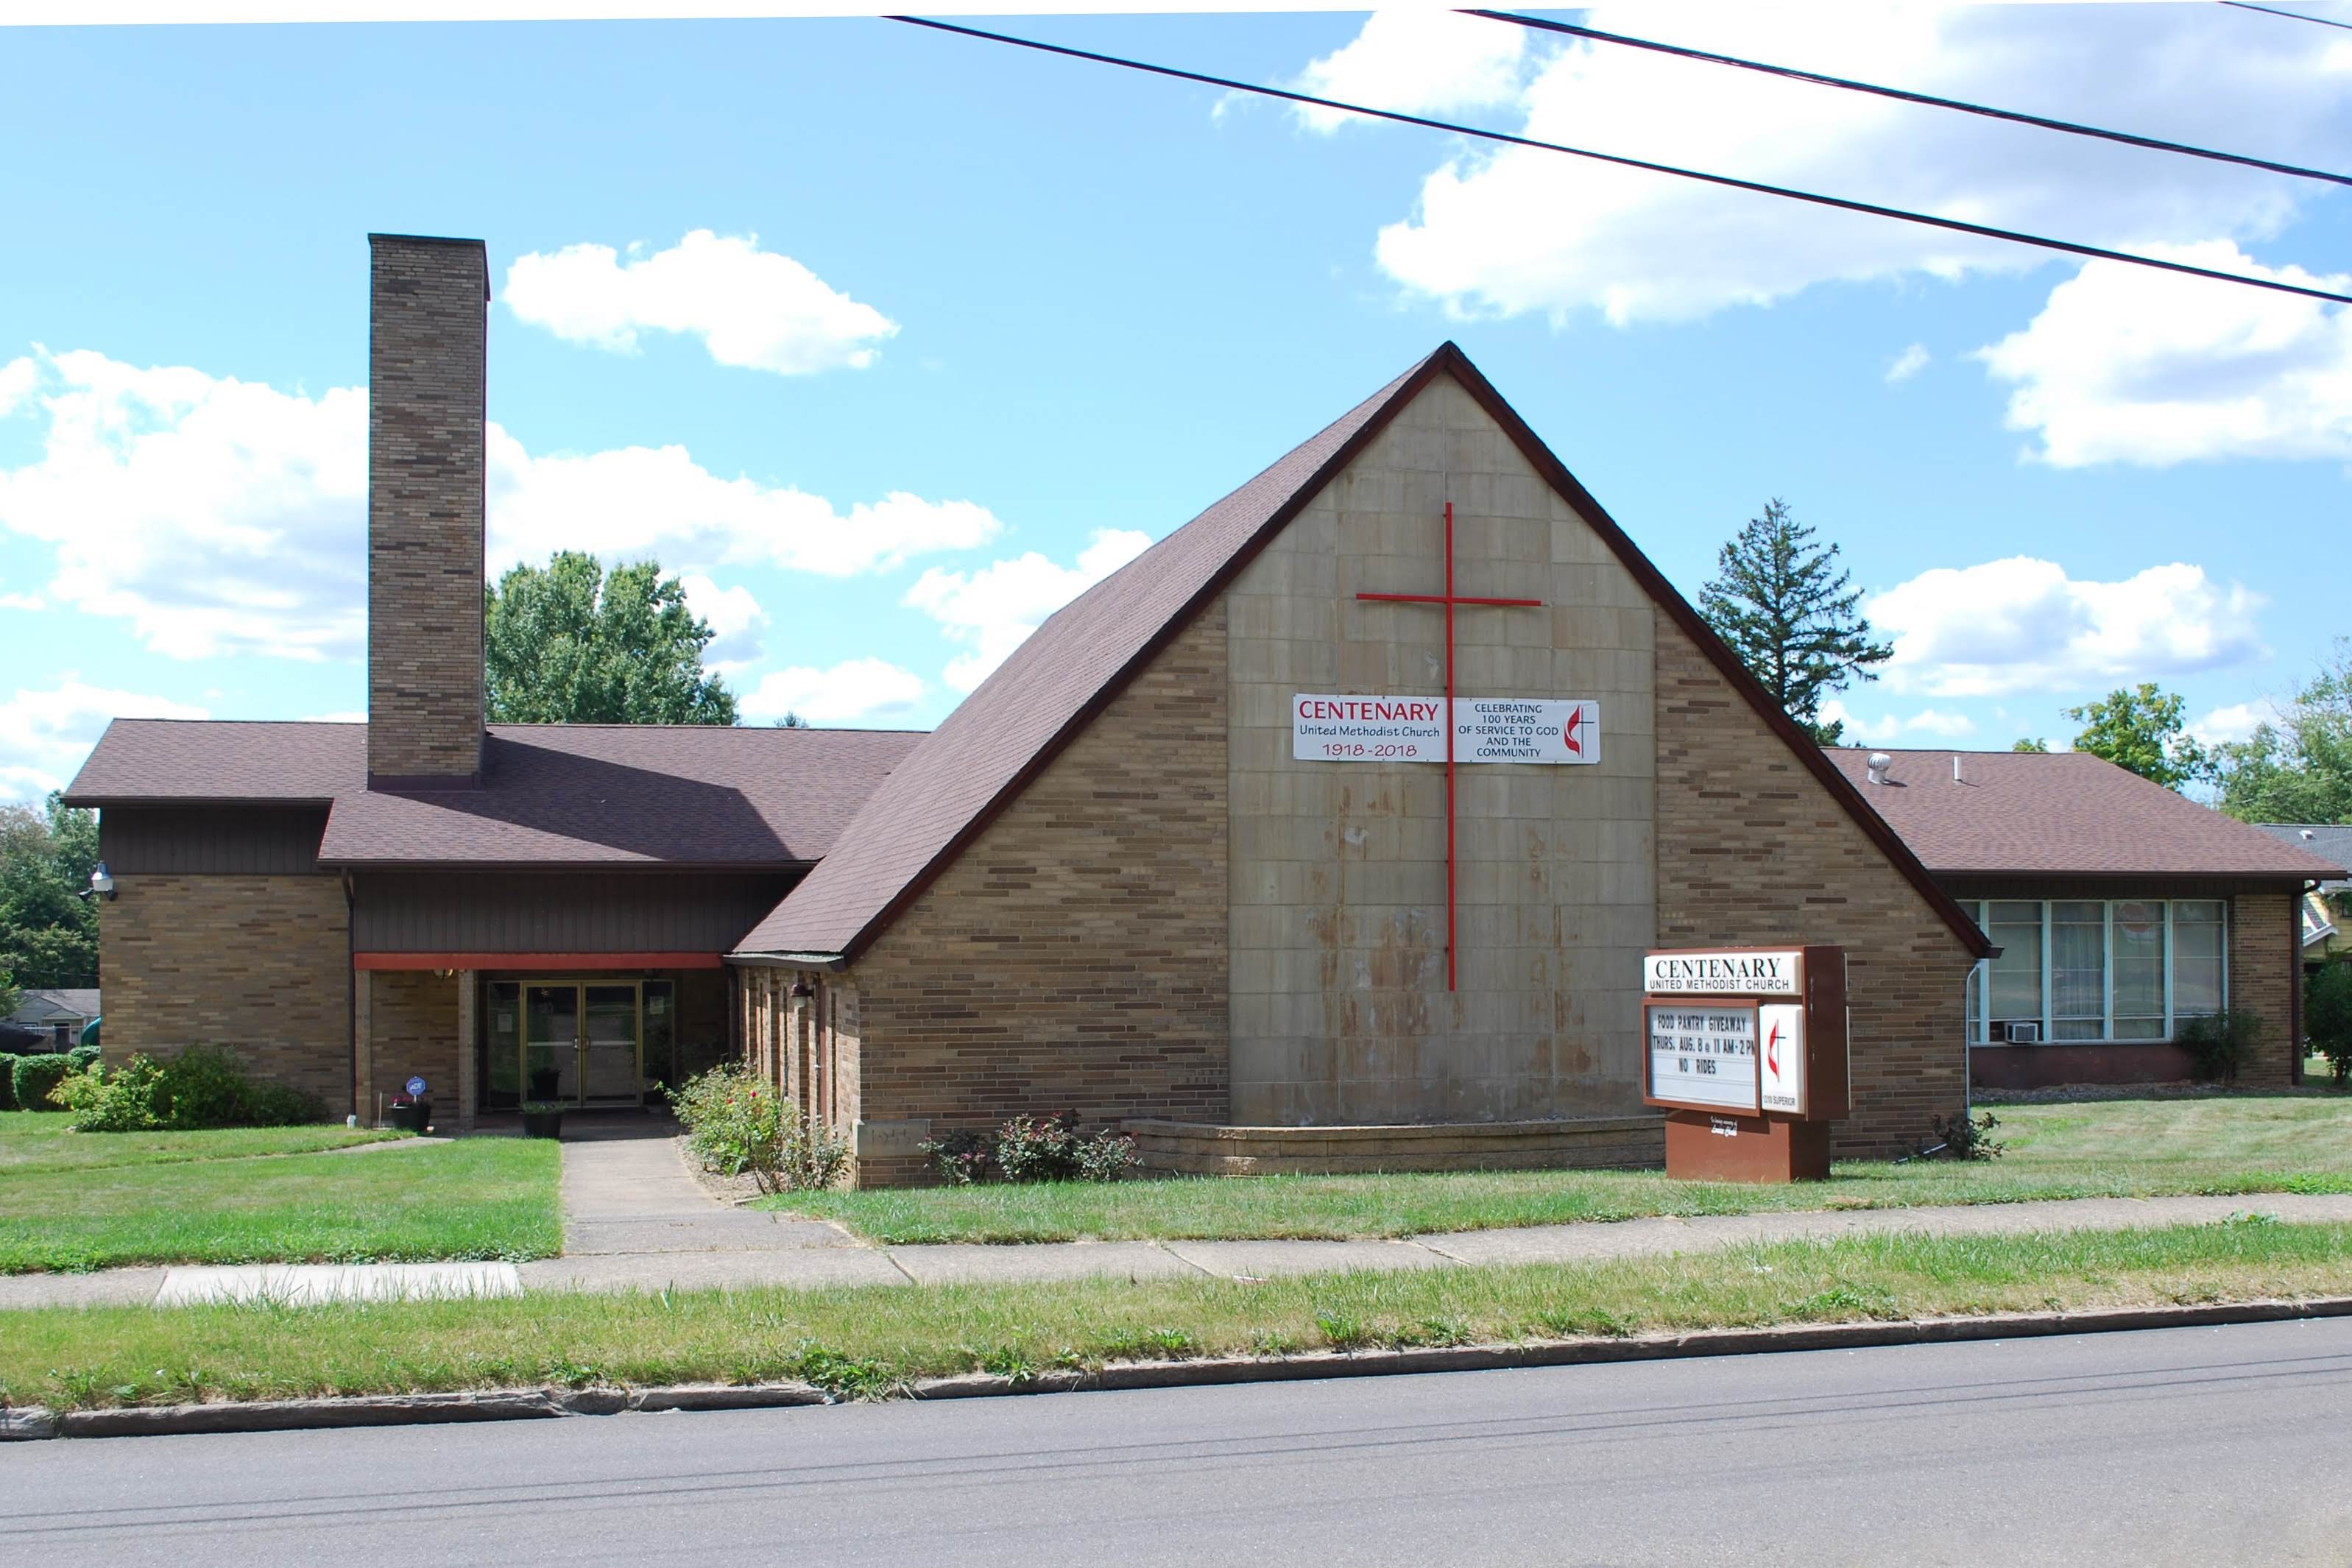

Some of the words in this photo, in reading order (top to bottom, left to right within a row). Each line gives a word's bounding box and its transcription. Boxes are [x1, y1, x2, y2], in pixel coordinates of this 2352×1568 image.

[1299, 701, 1438, 721] CENTENARY
[1475, 703, 1542, 713] CELEBRATING
[1483, 715, 1501, 724] 100
[1504, 716, 1536, 724] YEARS
[1299, 724, 1337, 735] United
[1339, 726, 1399, 736] Methodist
[1402, 727, 1440, 737] Church
[1458, 725, 1472, 734] OF
[1475, 726, 1516, 735] SERVICE
[1519, 727, 1533, 735] TO
[1536, 727, 1558, 735] GOD
[1486, 737, 1508, 746] AND
[1512, 738, 1531, 746] THE
[1477, 748, 1541, 757] COMMUNITY
[1656, 958, 1781, 978] CENTENARY
[1650, 980, 1682, 989] UNITED
[1687, 979, 1741, 989] METHODIST
[1745, 979, 1789, 990] CHURCH
[1658, 1014, 1674, 1029] FOOD
[1678, 1015, 1704, 1031] PANTRY
[1709, 1017, 1745, 1032] GIVEAWAY
[1653, 1035, 1675, 1050] THURS.
[1679, 1036, 1695, 1051] AUG.
[1697, 1037, 1703, 1052] 8
[1713, 1038, 1720, 1053] 11
[1678, 1058, 1688, 1072] NO
[1696, 1059, 1716, 1074] RIDES
